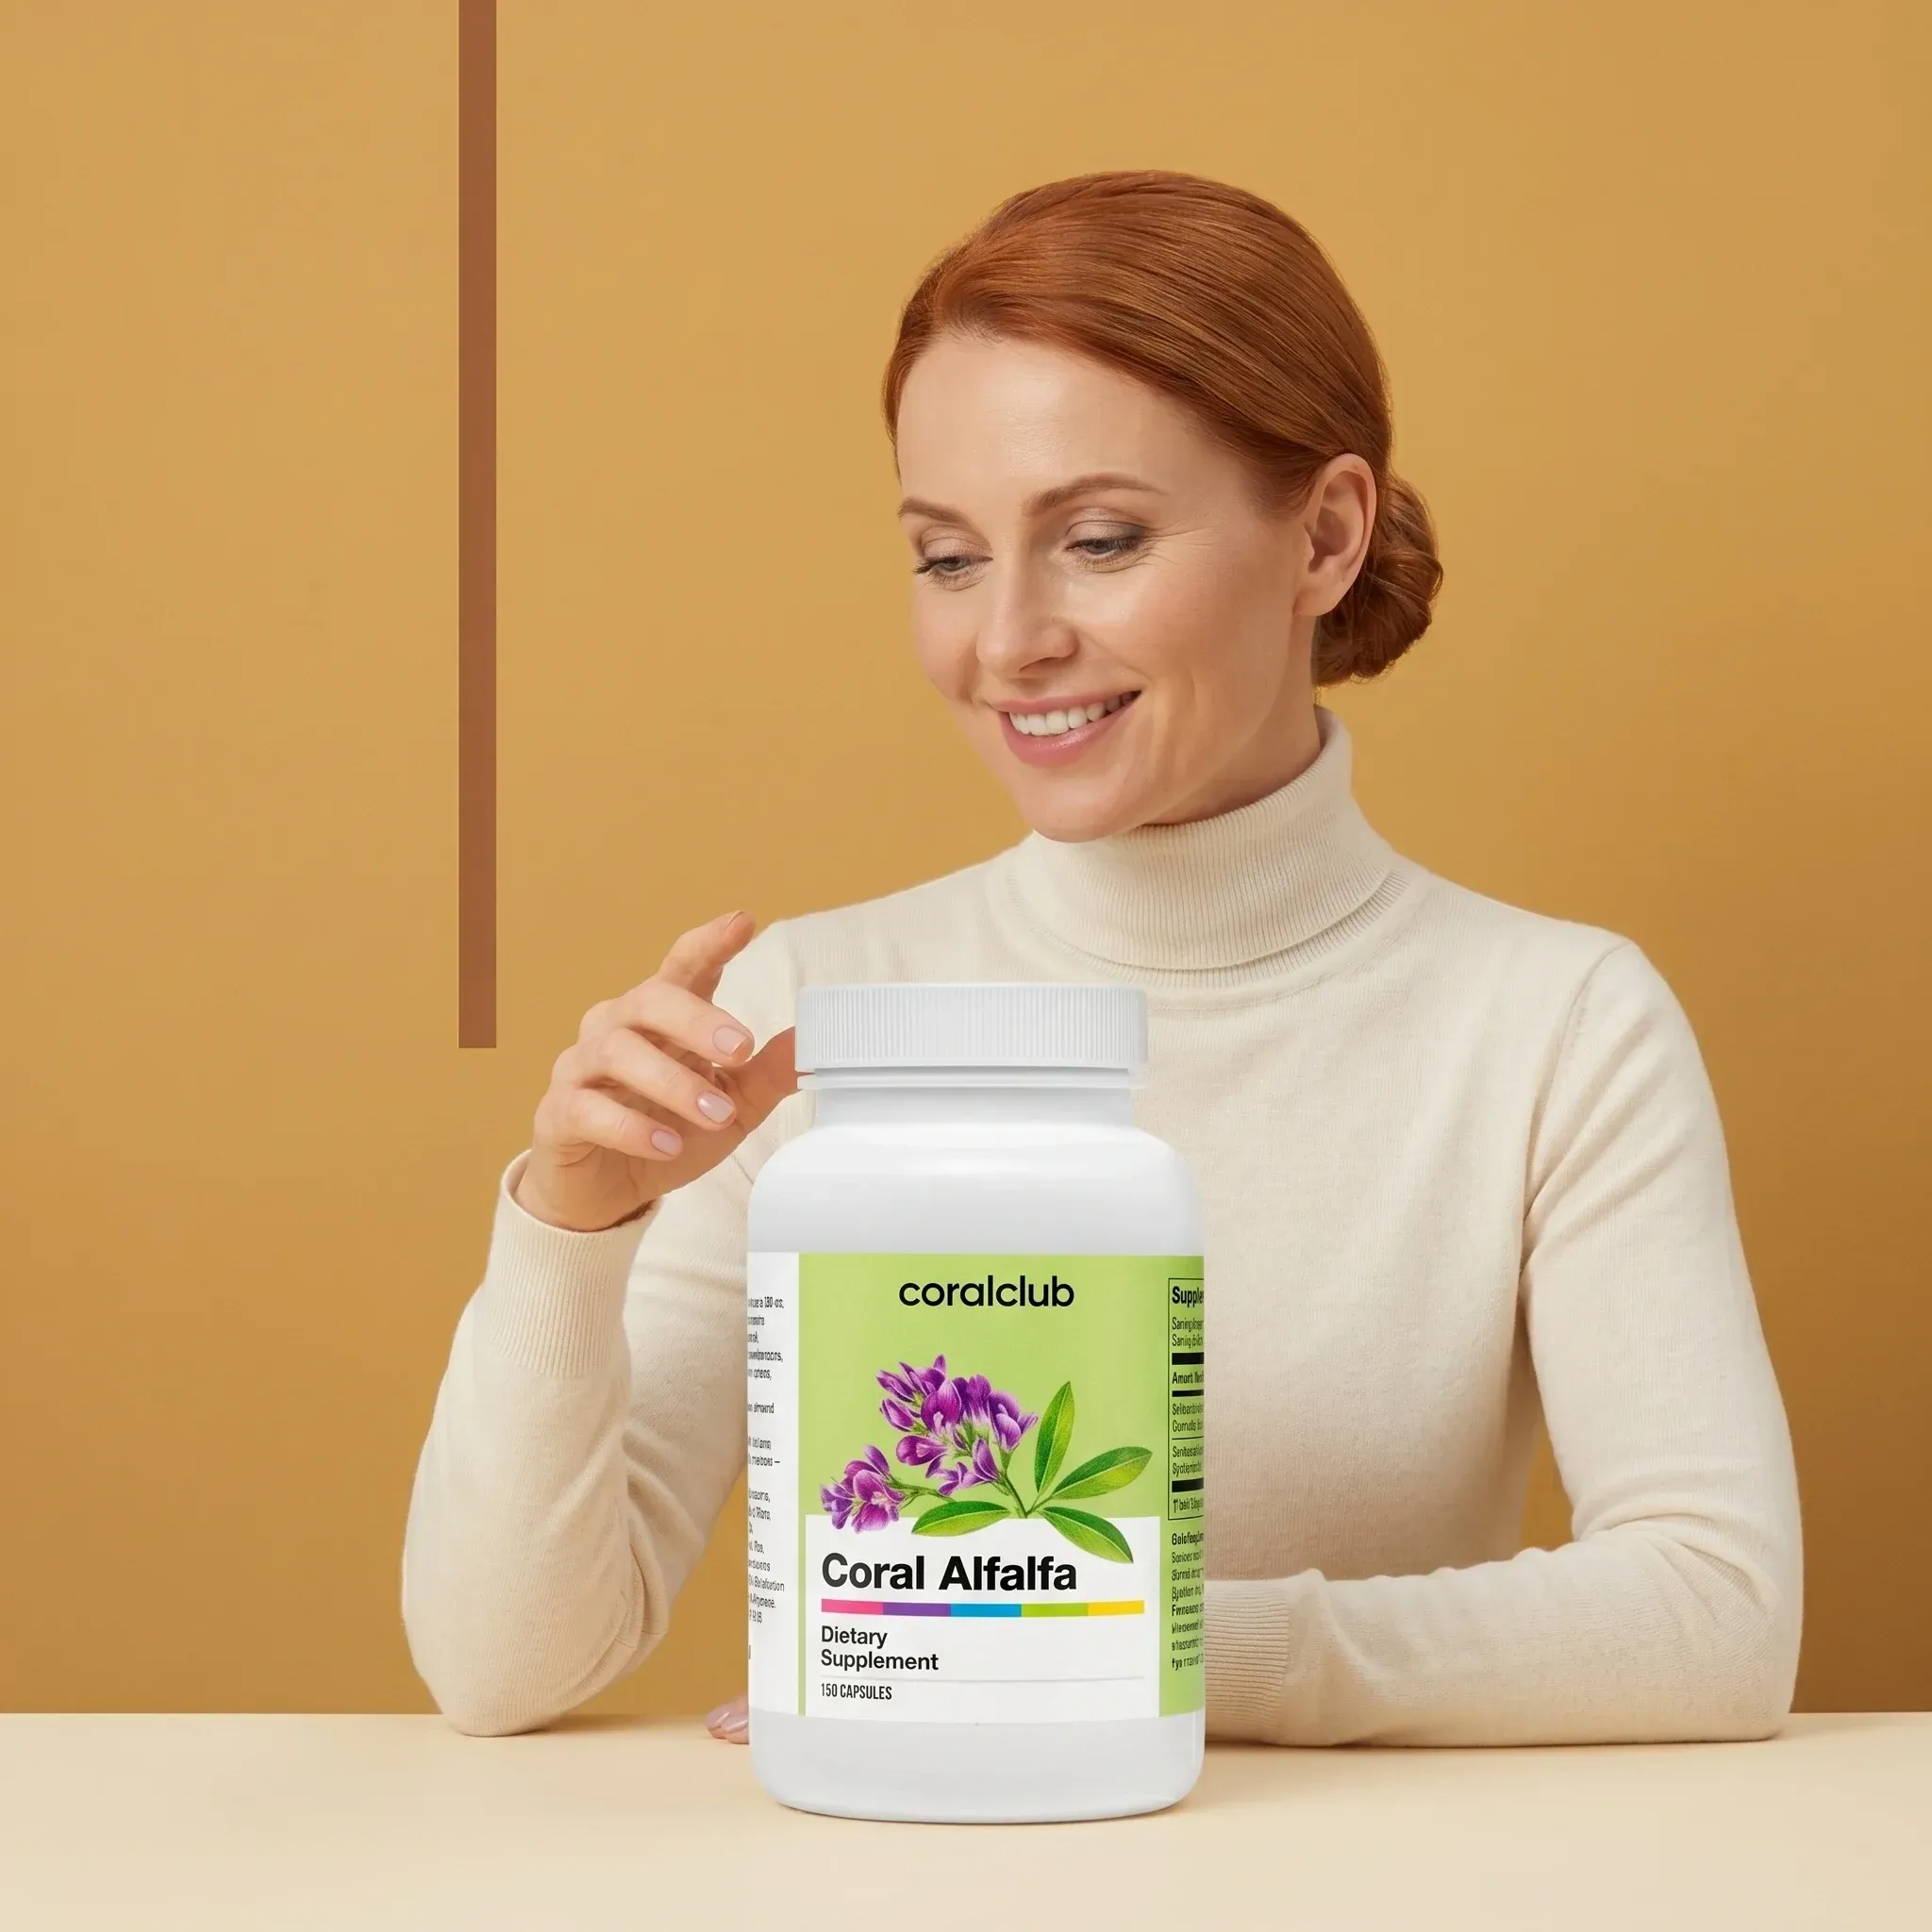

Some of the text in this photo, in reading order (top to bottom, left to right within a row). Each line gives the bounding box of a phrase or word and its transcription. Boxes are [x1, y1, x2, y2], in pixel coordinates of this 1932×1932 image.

[899, 1275, 1074, 1307] coralclub
[822, 1552, 925, 1591] Coral
[939, 1556, 1077, 1591] Alfalfa
[822, 1625, 888, 1648] Dietary
[822, 1649, 940, 1673] Supplement
[821, 1683, 892, 1701] 150 CAPSULES
